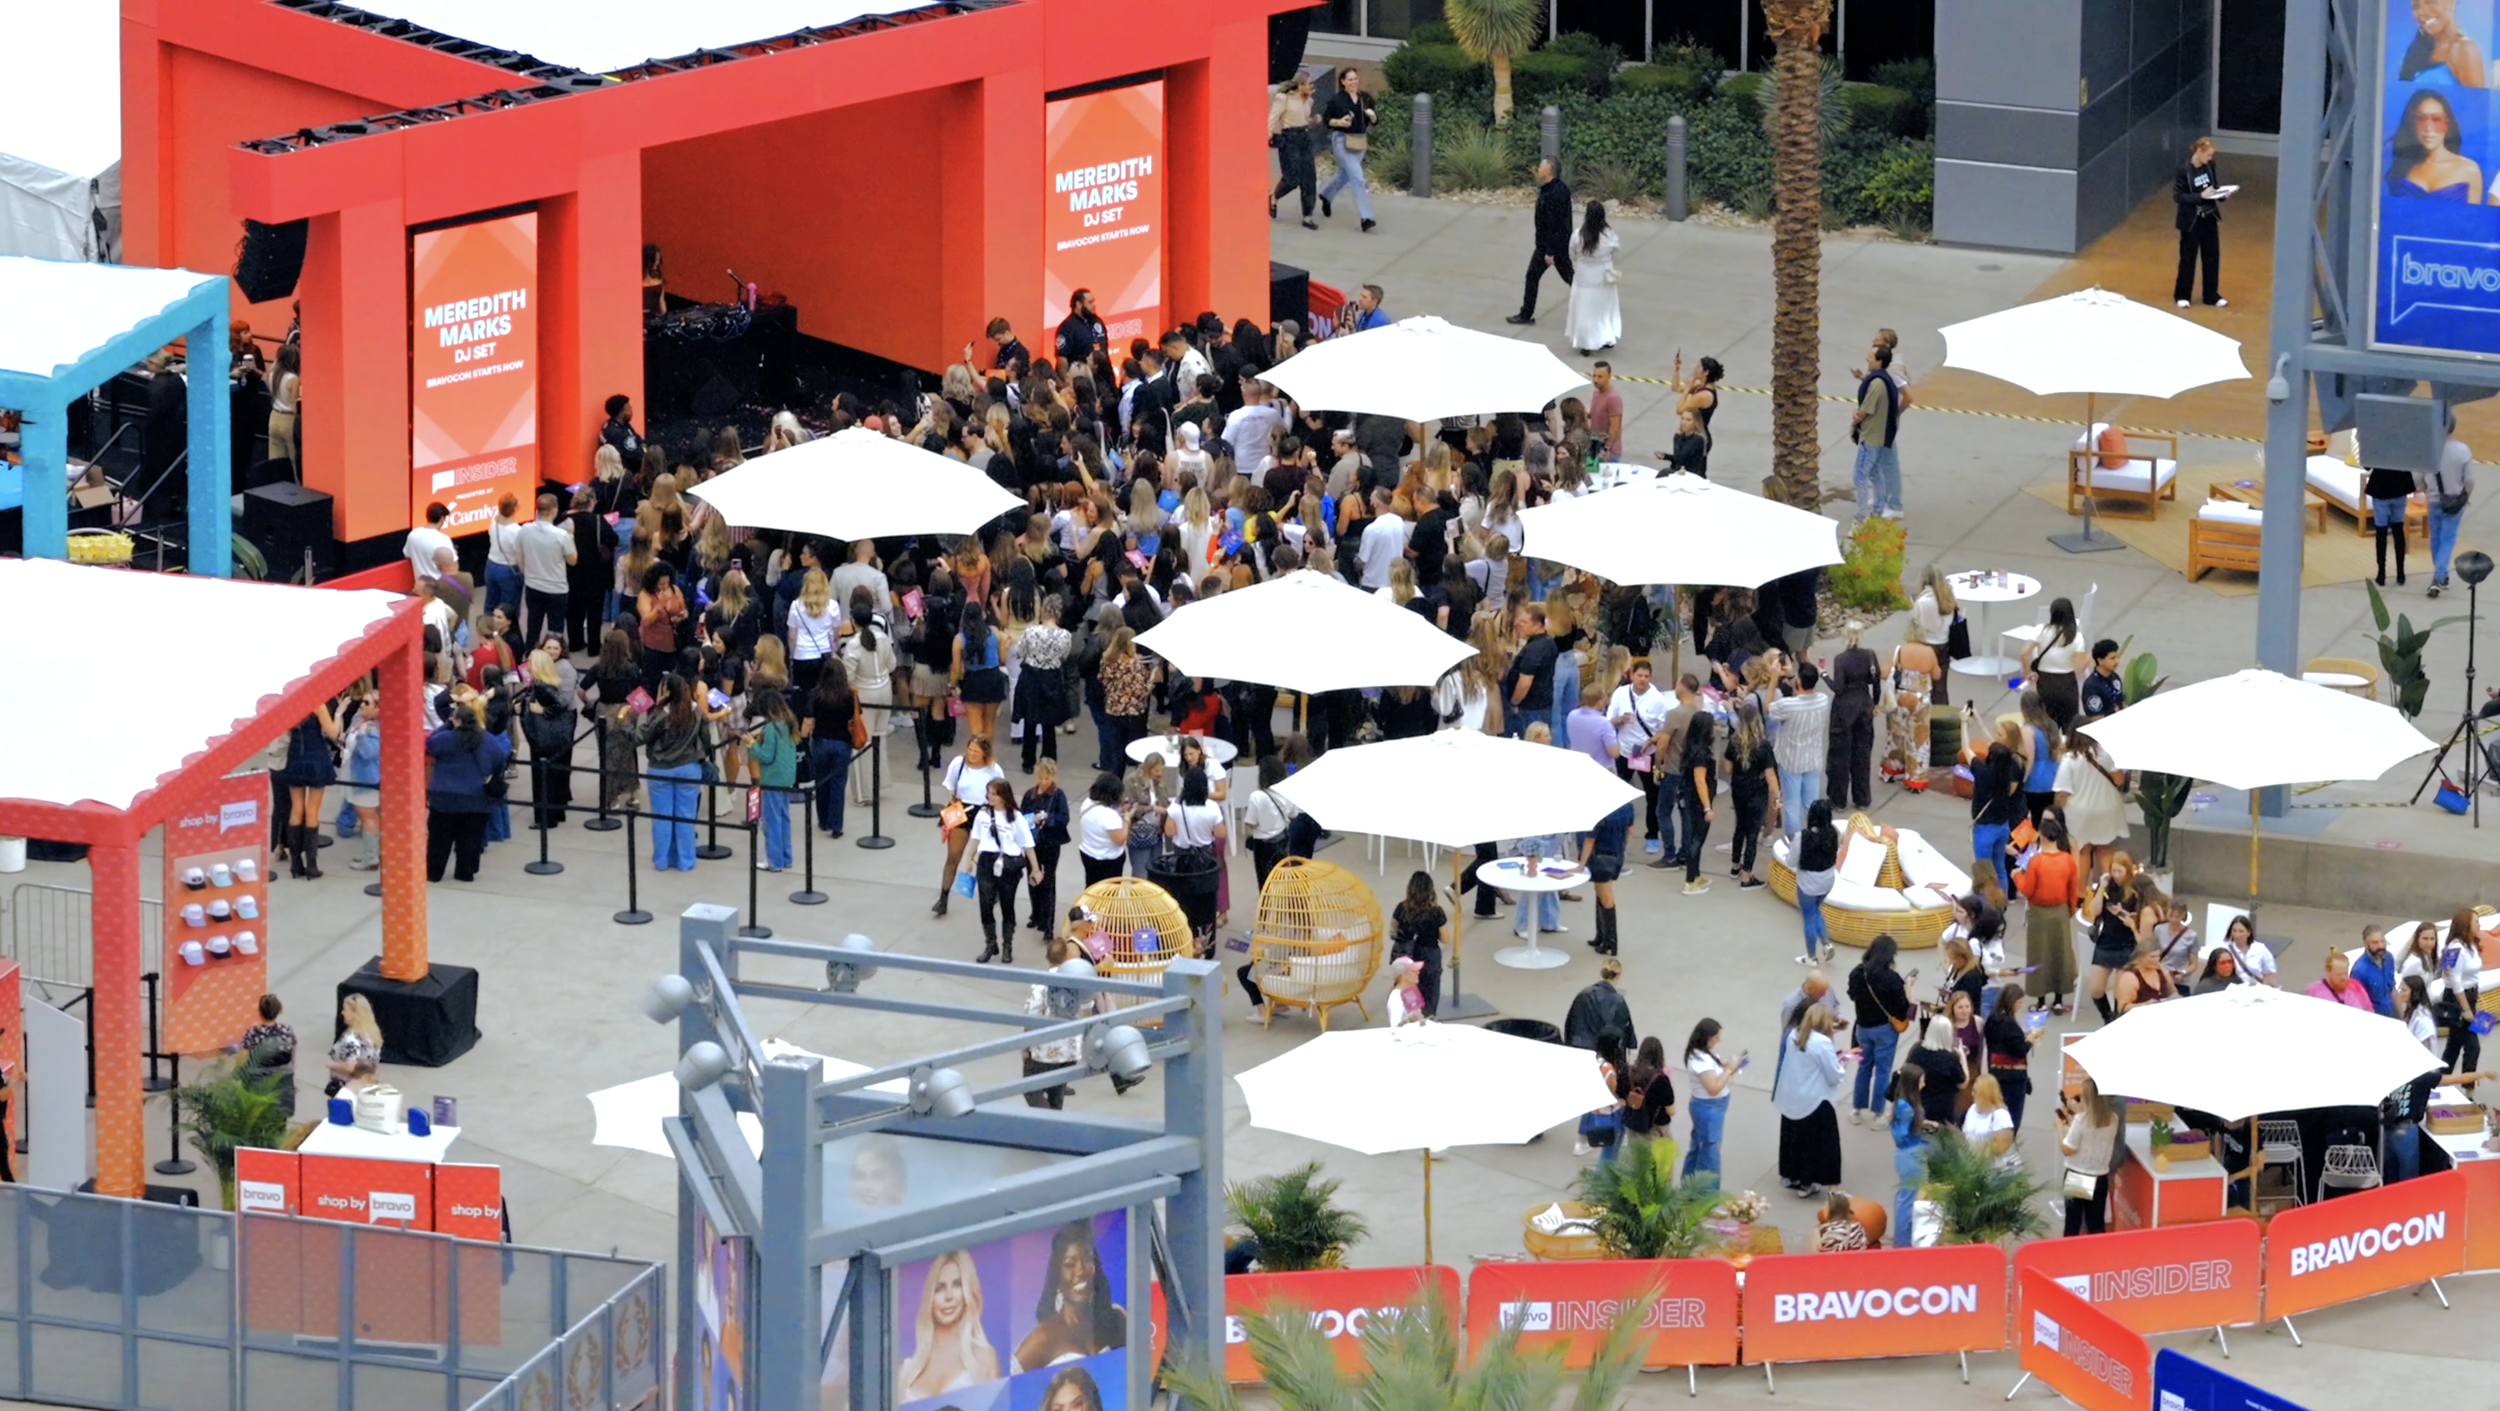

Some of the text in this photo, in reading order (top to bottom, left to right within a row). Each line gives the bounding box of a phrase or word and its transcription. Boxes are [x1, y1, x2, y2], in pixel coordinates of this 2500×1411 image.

[1056, 155, 1152, 193] MEREDITH
[1070, 180, 1138, 212] MARKS
[1084, 206, 1124, 227] DJ SET
[1057, 224, 1150, 251] BRAVOCON STARTS NOW
[2402, 251, 2500, 292] bravo
[425, 288, 526, 328] MEREDITH
[440, 314, 512, 347] MARKS
[455, 342, 496, 363] DJ SET
[426, 360, 524, 388] BRAVOCON STARTS NOW
[455, 457, 517, 485] INSIDER
[450, 504, 499, 526] Carniv
[179, 808, 254, 829] shop by bravo
[243, 1187, 281, 1202] bravo
[318, 1195, 412, 1212] shop by bravo
[451, 1204, 500, 1219] shop by
[2291, 1210, 2446, 1277] BRAVOCON
[2094, 1259, 2232, 1302] INSIDER
[1503, 1310, 1548, 1322] bavo
[1774, 1284, 1977, 1323] BRAVOCON
[2036, 1320, 2133, 1399] bravo INSIDER
